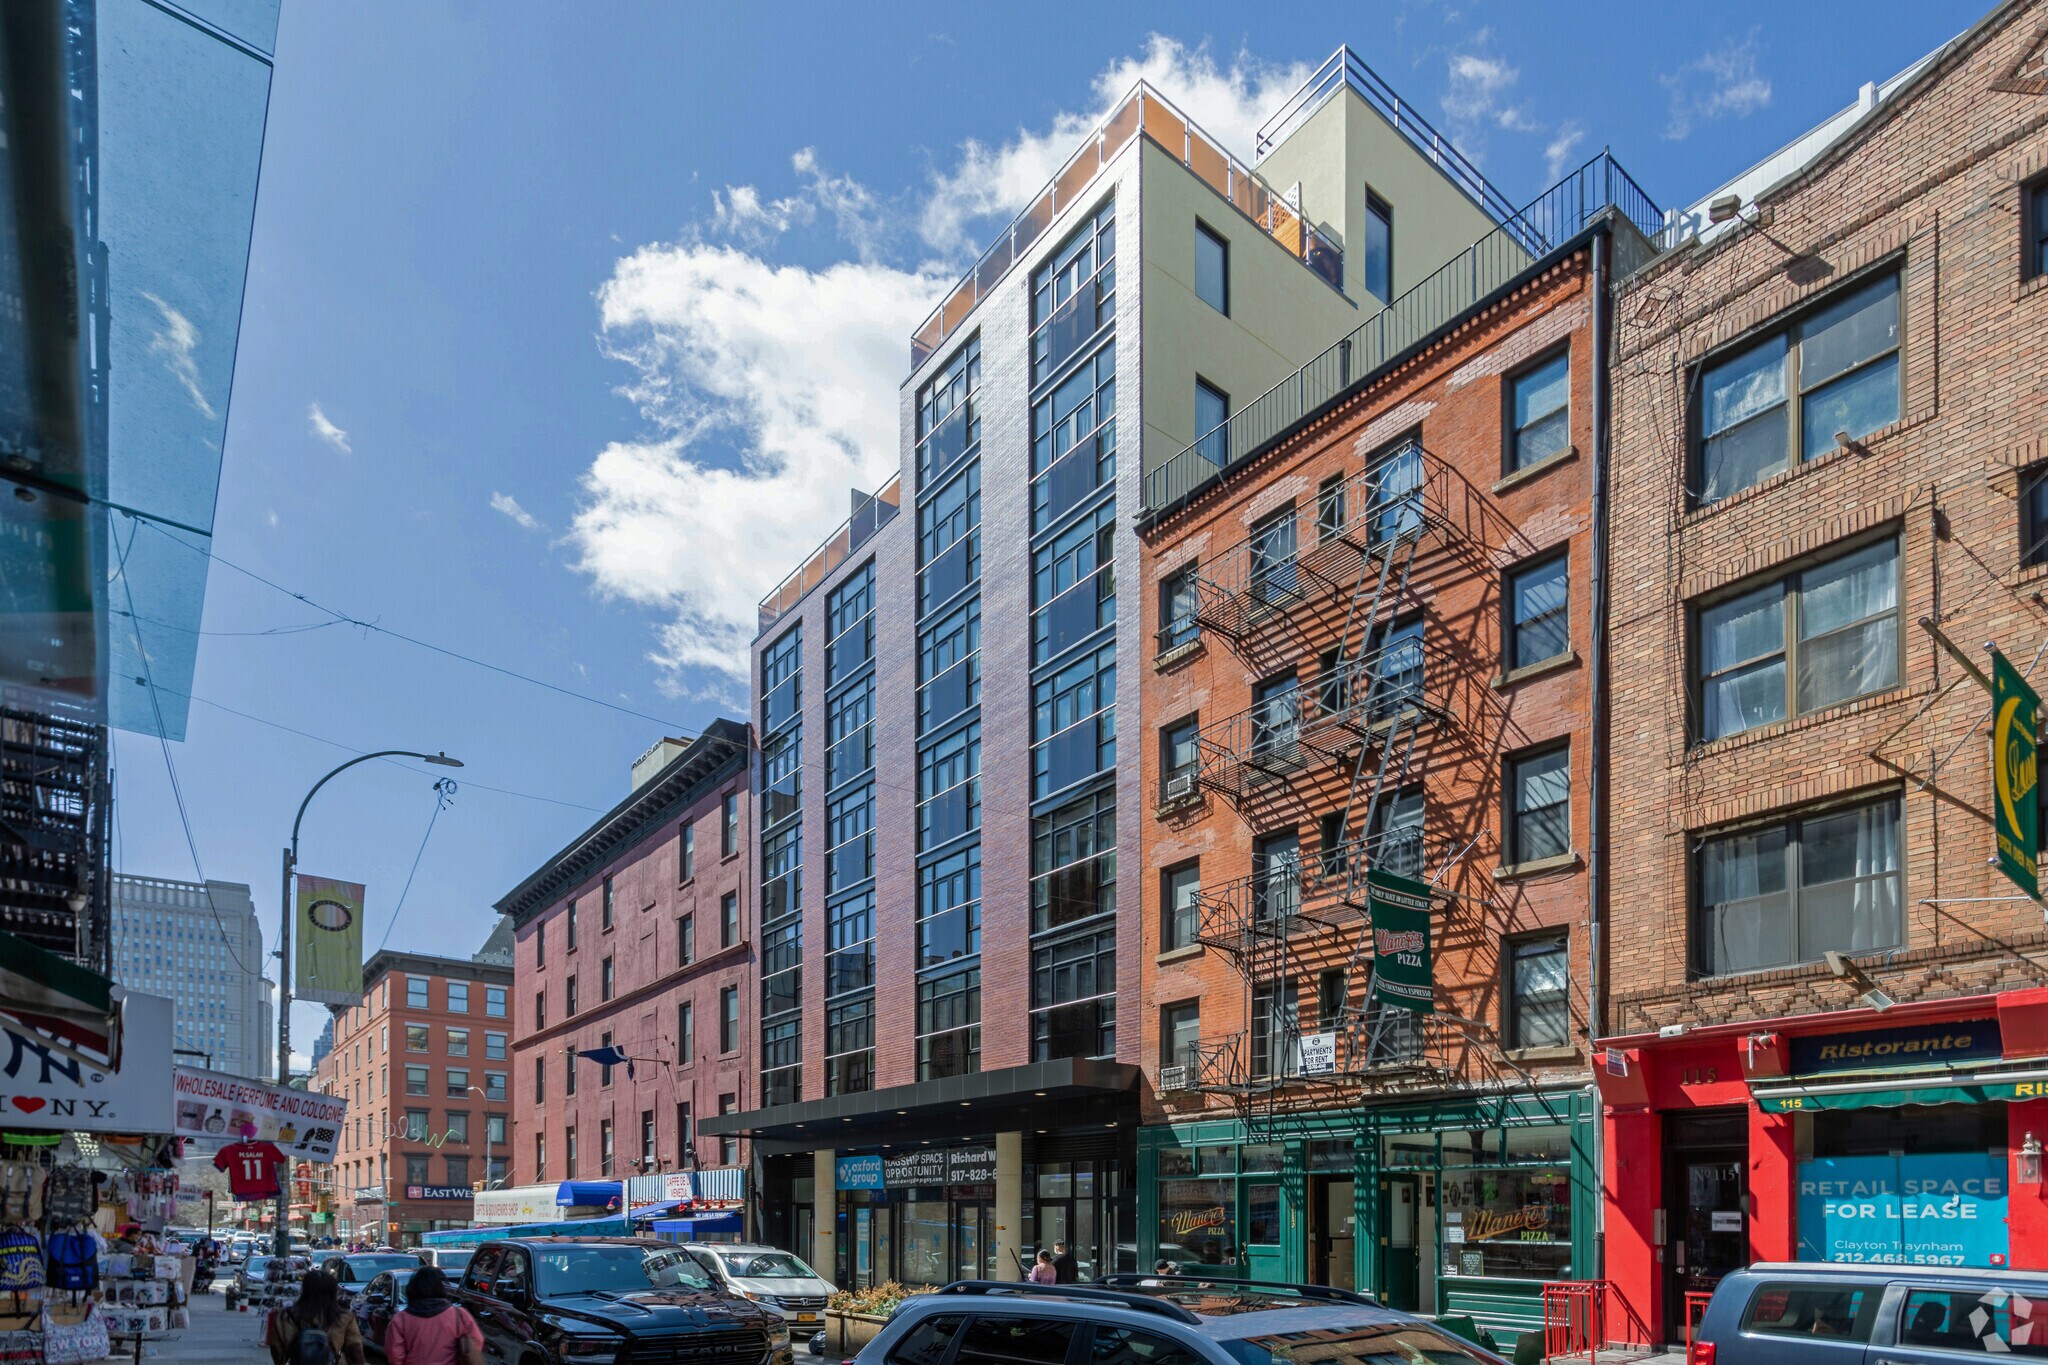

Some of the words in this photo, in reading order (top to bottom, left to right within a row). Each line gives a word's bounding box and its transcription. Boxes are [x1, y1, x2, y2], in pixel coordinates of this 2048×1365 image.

[1401, 896, 1415, 906] LITTLE
[1415, 899, 1428, 909] ITALY
[1397, 953, 1422, 967] PIZZA
[1408, 987, 1431, 998] ESPRESSO
[1304, 1046, 1333, 1057] PARTMENTS
[1819, 1034, 1973, 1060] Ristorante
[1315, 1055, 1329, 1064] RENT
[1682, 1068, 1716, 1085] 115
[176, 1074, 236, 1101] WHOLESALE
[236, 1085, 280, 1110] PERFUME
[280, 1097, 300, 1114] AND
[300, 1099, 344, 1123] COLOGNE
[1780, 1099, 1802, 1109] 115
[884, 1155, 919, 1167] FLAGSHIP
[921, 1153, 943, 1164] SPACE
[951, 1151, 987, 1164] Richard
[243, 1160, 261, 1180] 11
[852, 1160, 881, 1172] oxford
[885, 1165, 943, 1178] OPPORTUNITY
[852, 1172, 878, 1186] group
[1715, 1169, 1735, 1180] 115
[1801, 1180, 1894, 1196] RETAIL
[1904, 1178, 2001, 1194] SPACE
[1822, 1203, 1876, 1219] FOR
[1886, 1203, 1977, 1219] LEASE
[1207, 1227, 1225, 1236] PIZZA
[1521, 1231, 1549, 1241] PIZZA
[1834, 1240, 1887, 1251] Clayton
[1892, 1241, 1963, 1252] Traynham
[1834, 1252, 1965, 1266] 212.468.5967
[676, 1345, 732, 1356] RAM
